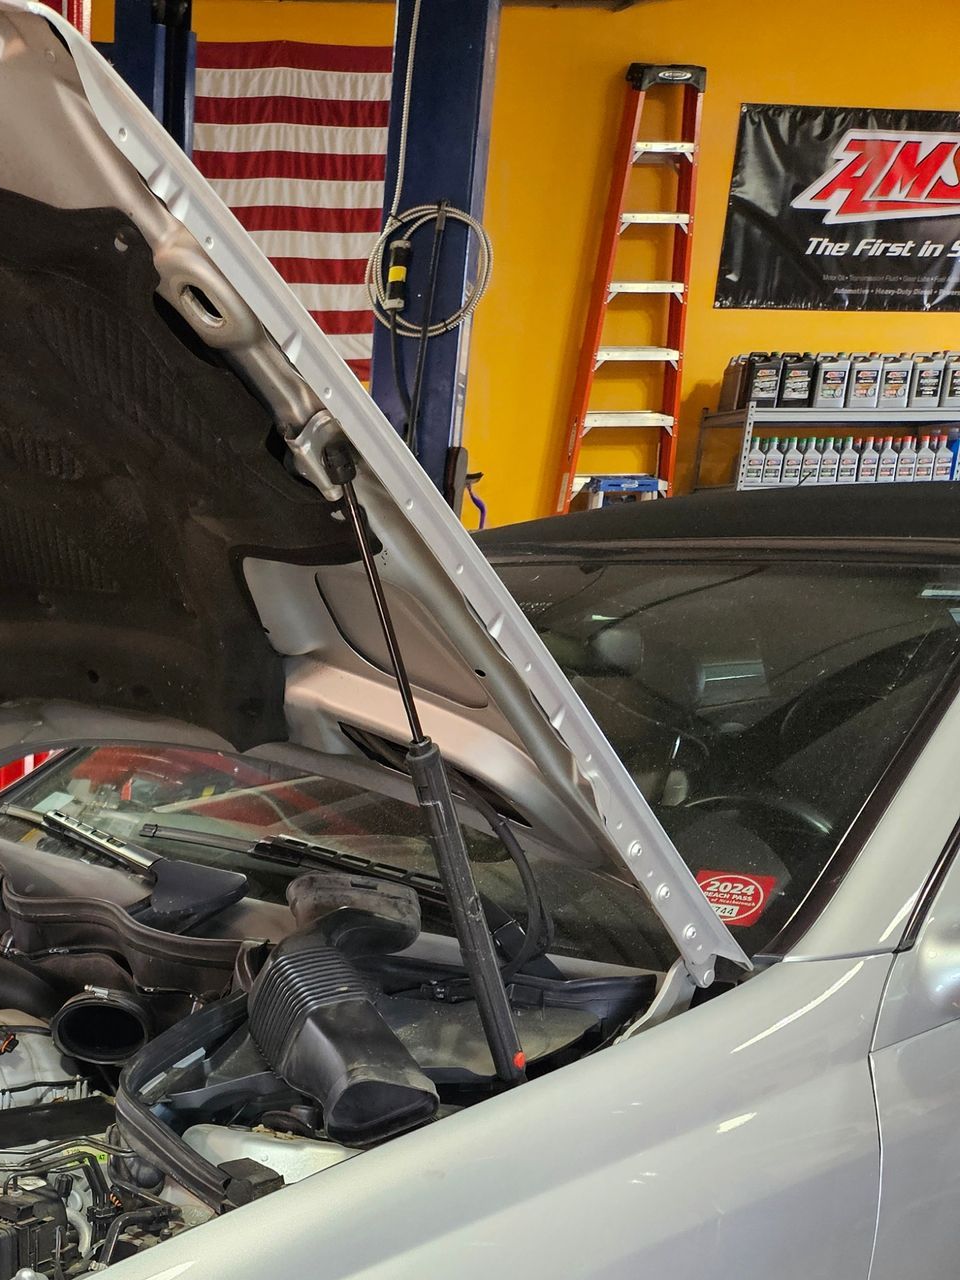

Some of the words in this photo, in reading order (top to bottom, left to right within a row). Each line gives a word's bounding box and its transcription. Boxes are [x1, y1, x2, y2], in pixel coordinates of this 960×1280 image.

[805, 237, 851, 256] The
[852, 238, 916, 257] First
[917, 240, 945, 257] in
[874, 287, 912, 296] Heavy-Duty
[706, 881, 755, 895] 2024
[731, 894, 753, 902] PASS
